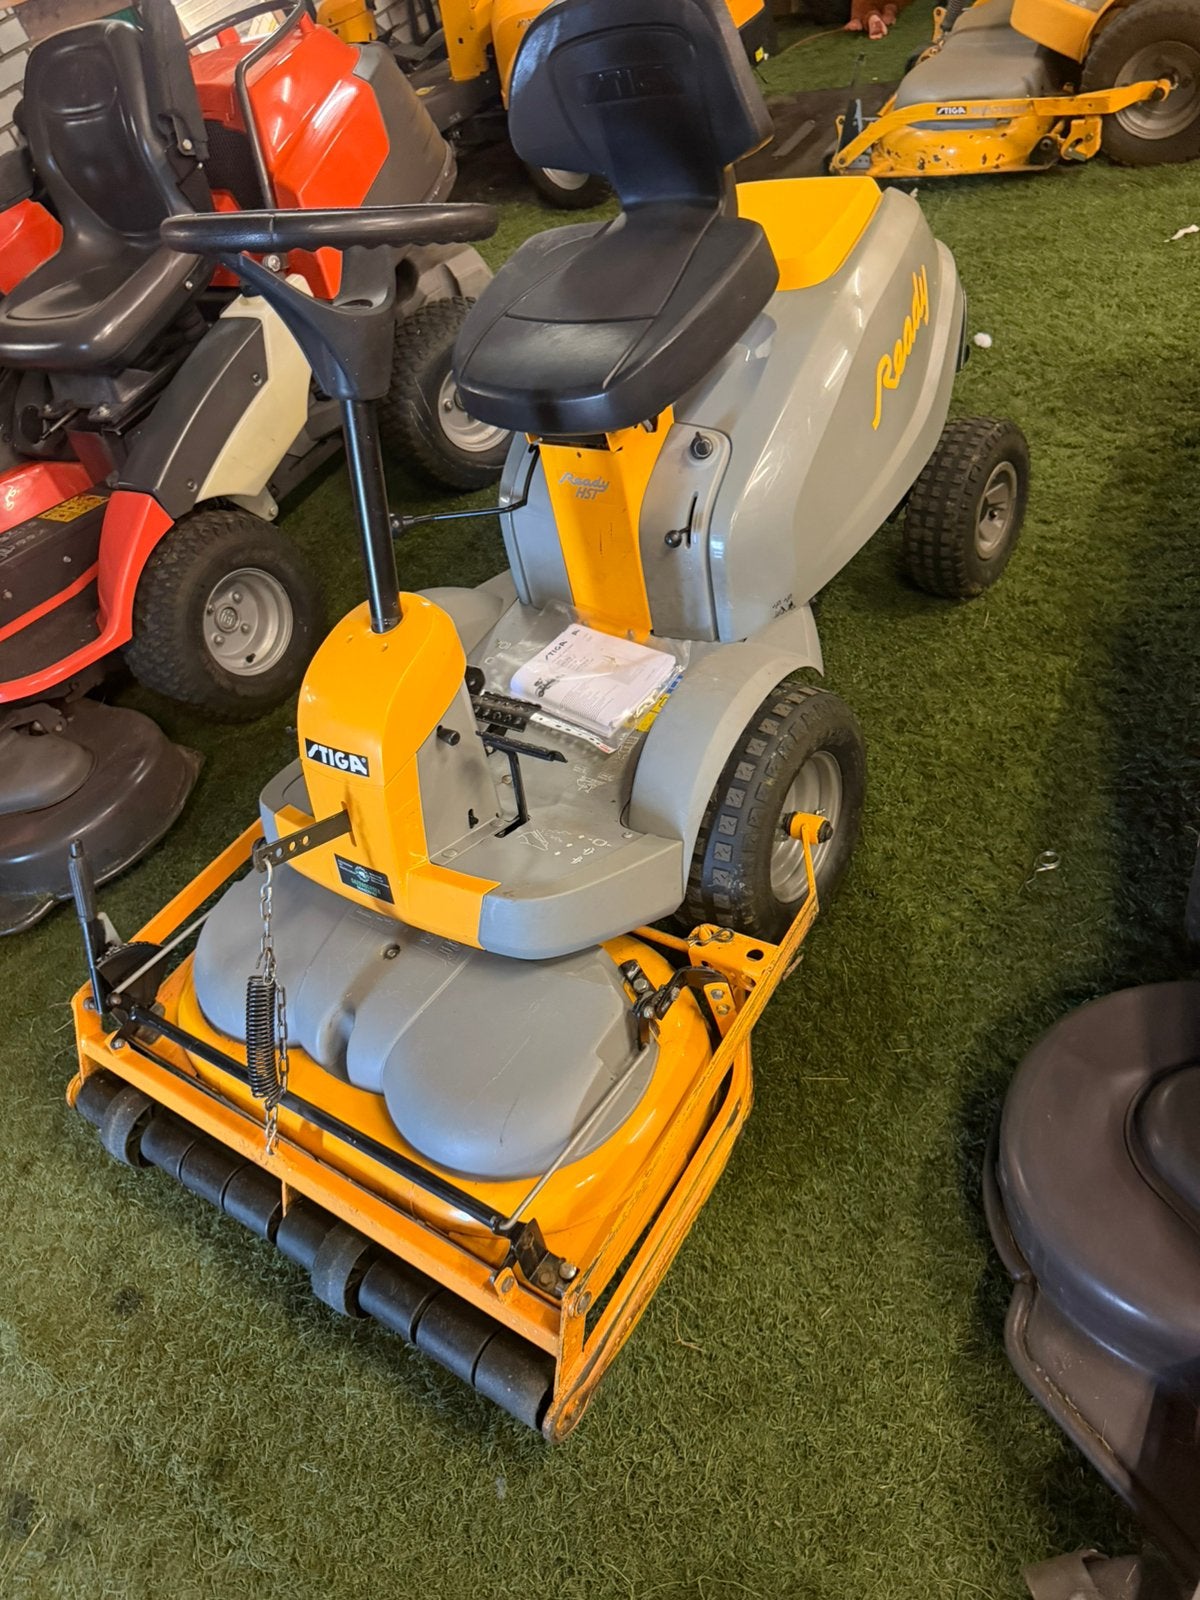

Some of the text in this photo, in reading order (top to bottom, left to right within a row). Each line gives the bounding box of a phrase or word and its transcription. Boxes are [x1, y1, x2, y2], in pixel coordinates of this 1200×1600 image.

[872, 264, 929, 431] Ready
[559, 472, 610, 492] Ready
[575, 486, 598, 500] HST
[545, 641, 568, 661] STIGA
[308, 743, 368, 776] STIGA
